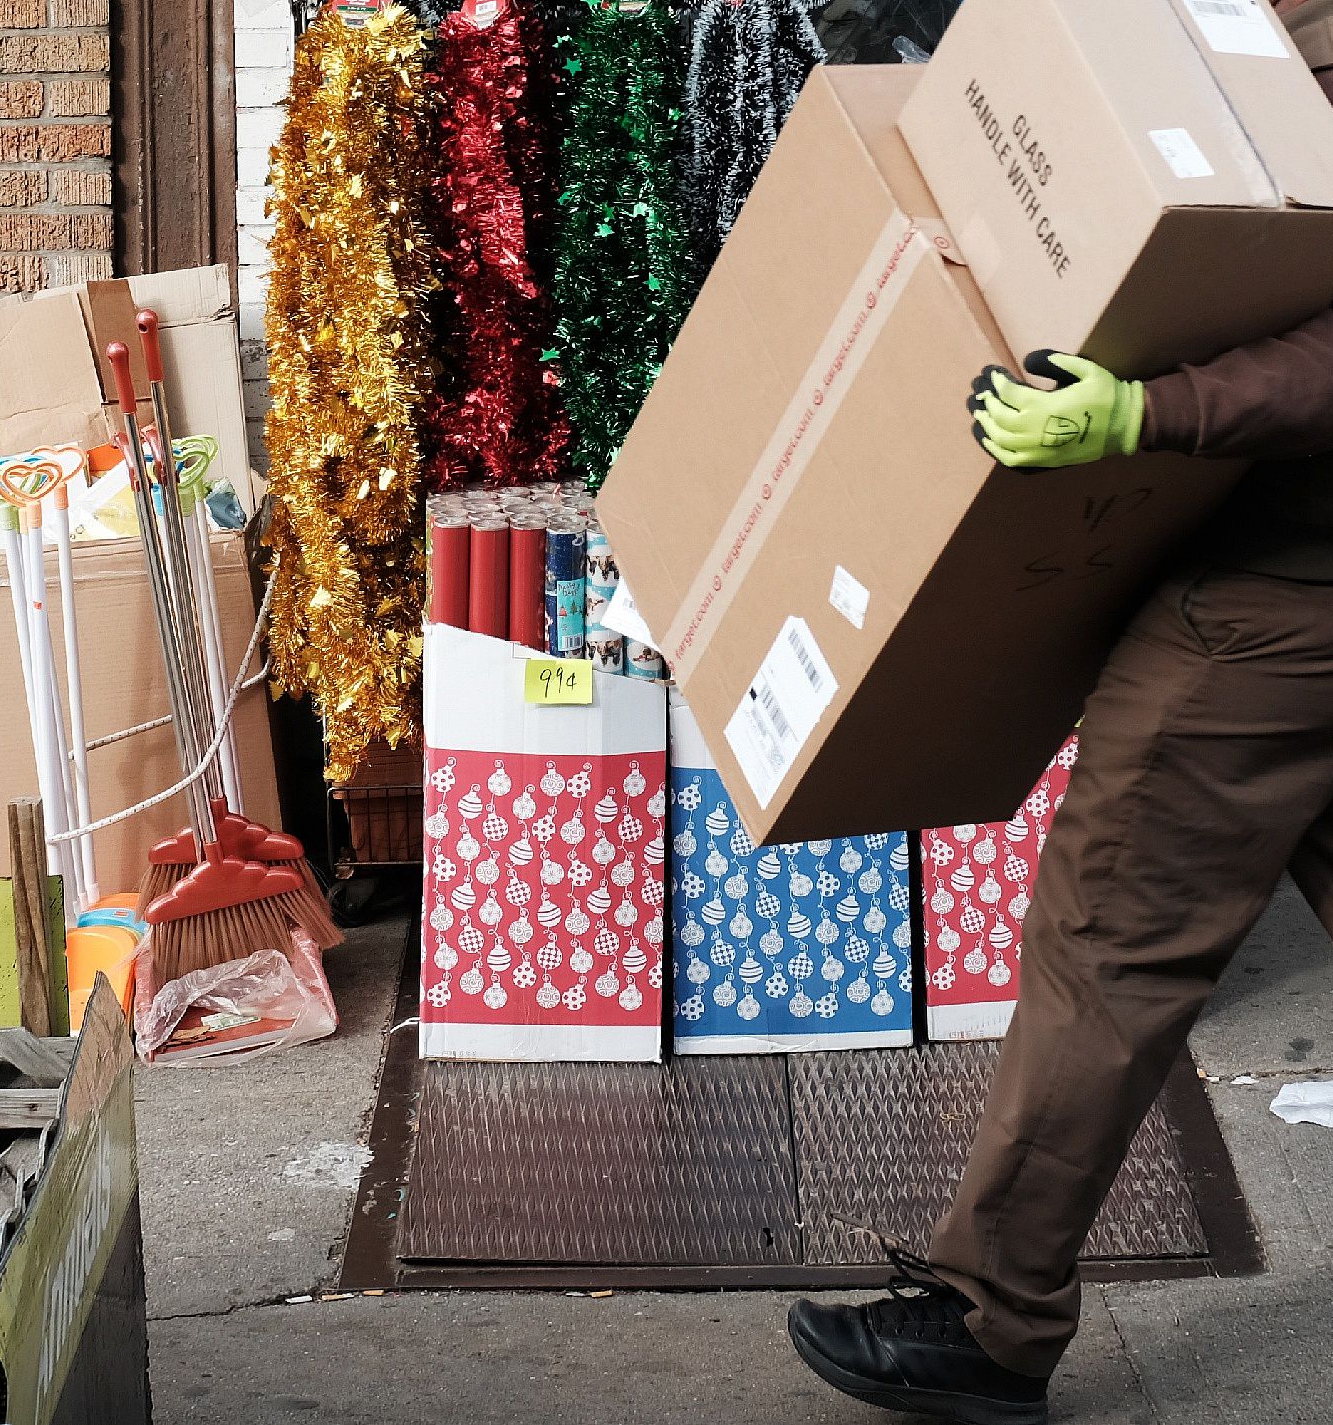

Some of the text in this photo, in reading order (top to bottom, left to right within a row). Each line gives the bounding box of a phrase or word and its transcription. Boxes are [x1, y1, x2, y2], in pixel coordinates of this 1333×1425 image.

[965, 78, 1071, 279] HANDLE WITH CARE
[1013, 115, 1053, 187] GLASS
